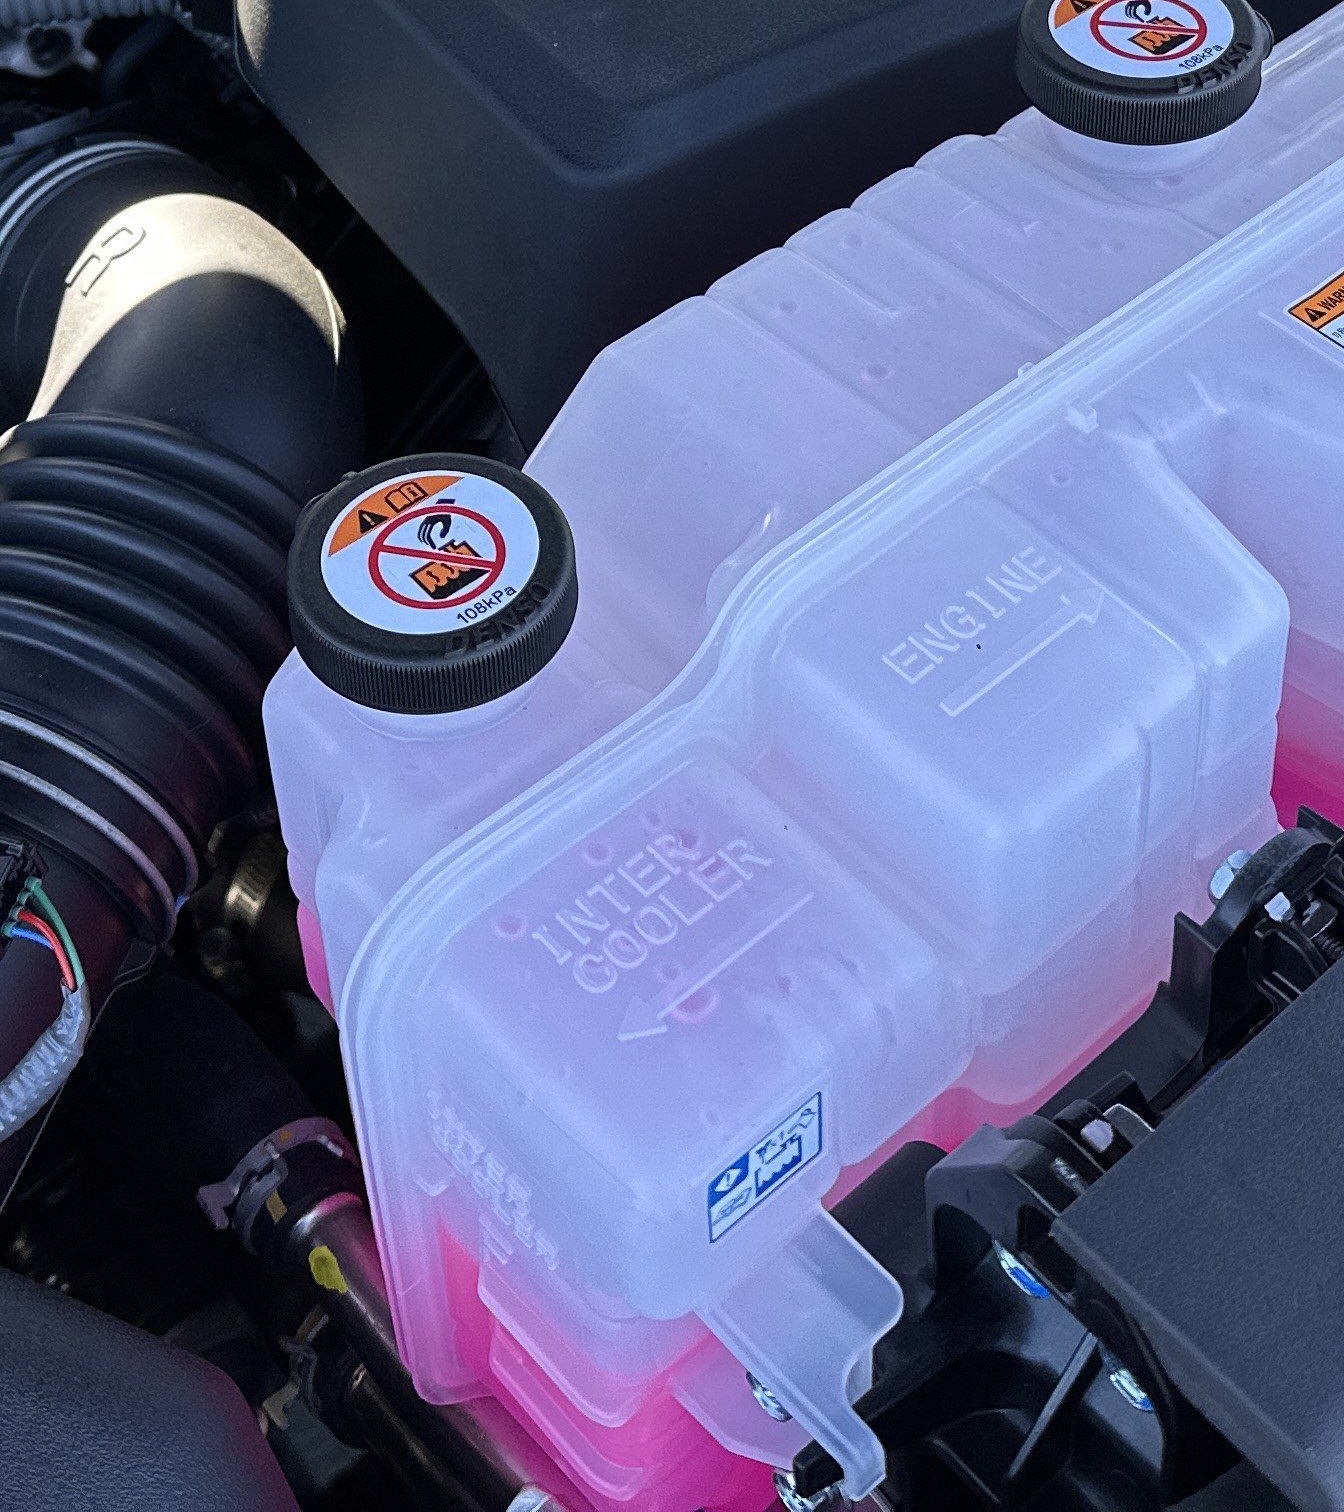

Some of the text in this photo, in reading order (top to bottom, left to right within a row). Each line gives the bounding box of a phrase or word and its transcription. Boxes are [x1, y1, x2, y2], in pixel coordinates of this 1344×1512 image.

[456, 585, 518, 624] 108kPa
[880, 545, 1063, 684] ENGINE
[530, 832, 714, 966] INTER
[572, 837, 776, 996] COOLER
